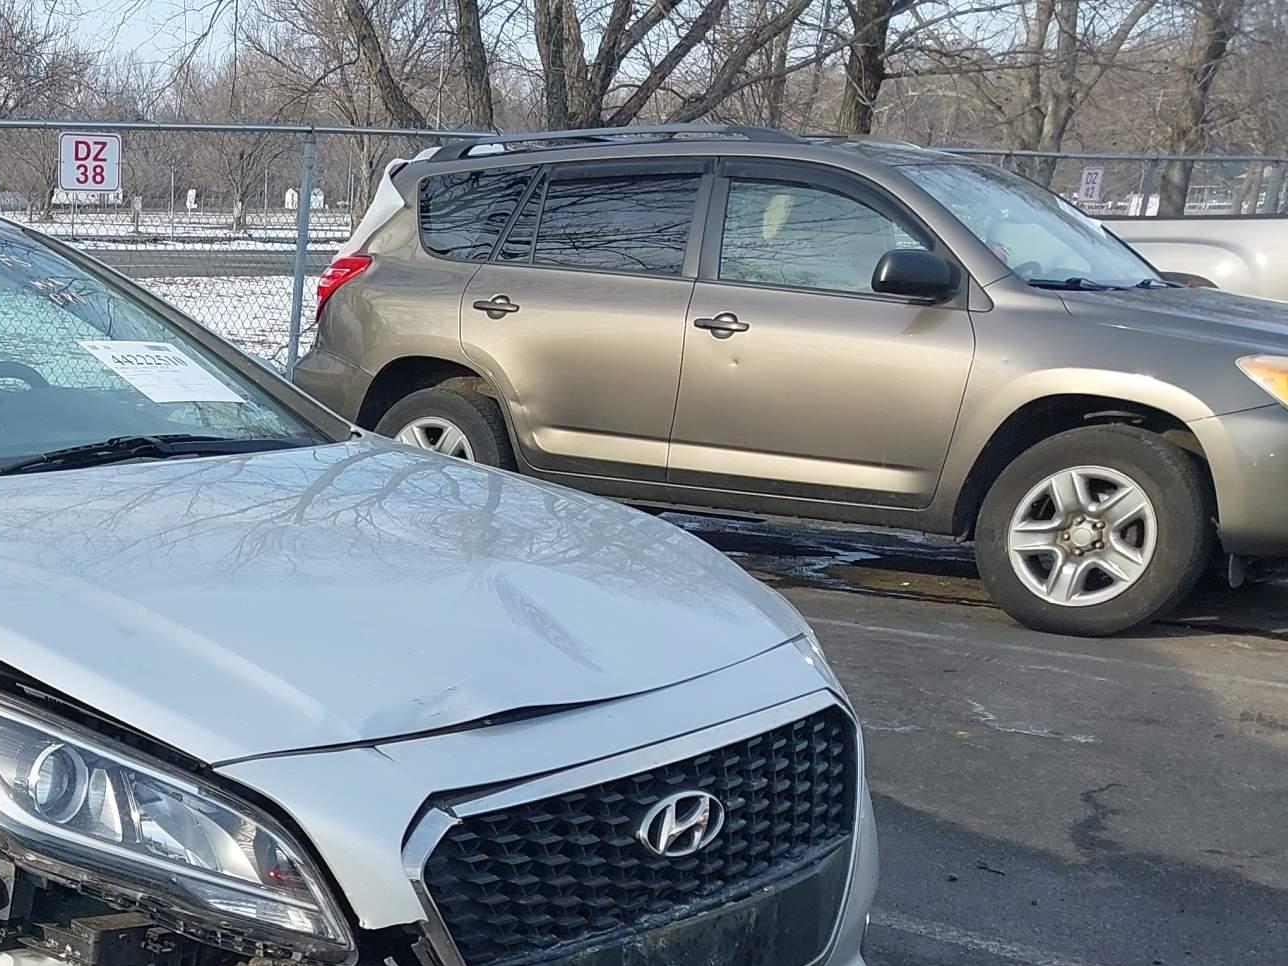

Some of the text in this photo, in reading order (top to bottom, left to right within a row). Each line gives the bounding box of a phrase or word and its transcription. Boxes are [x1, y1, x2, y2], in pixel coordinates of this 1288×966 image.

[74, 140, 108, 162] DZ
[75, 163, 105, 185] 38
[1085, 172, 1099, 184] DZ
[1084, 186, 1096, 198] 42
[111, 353, 189, 367] 44222510
